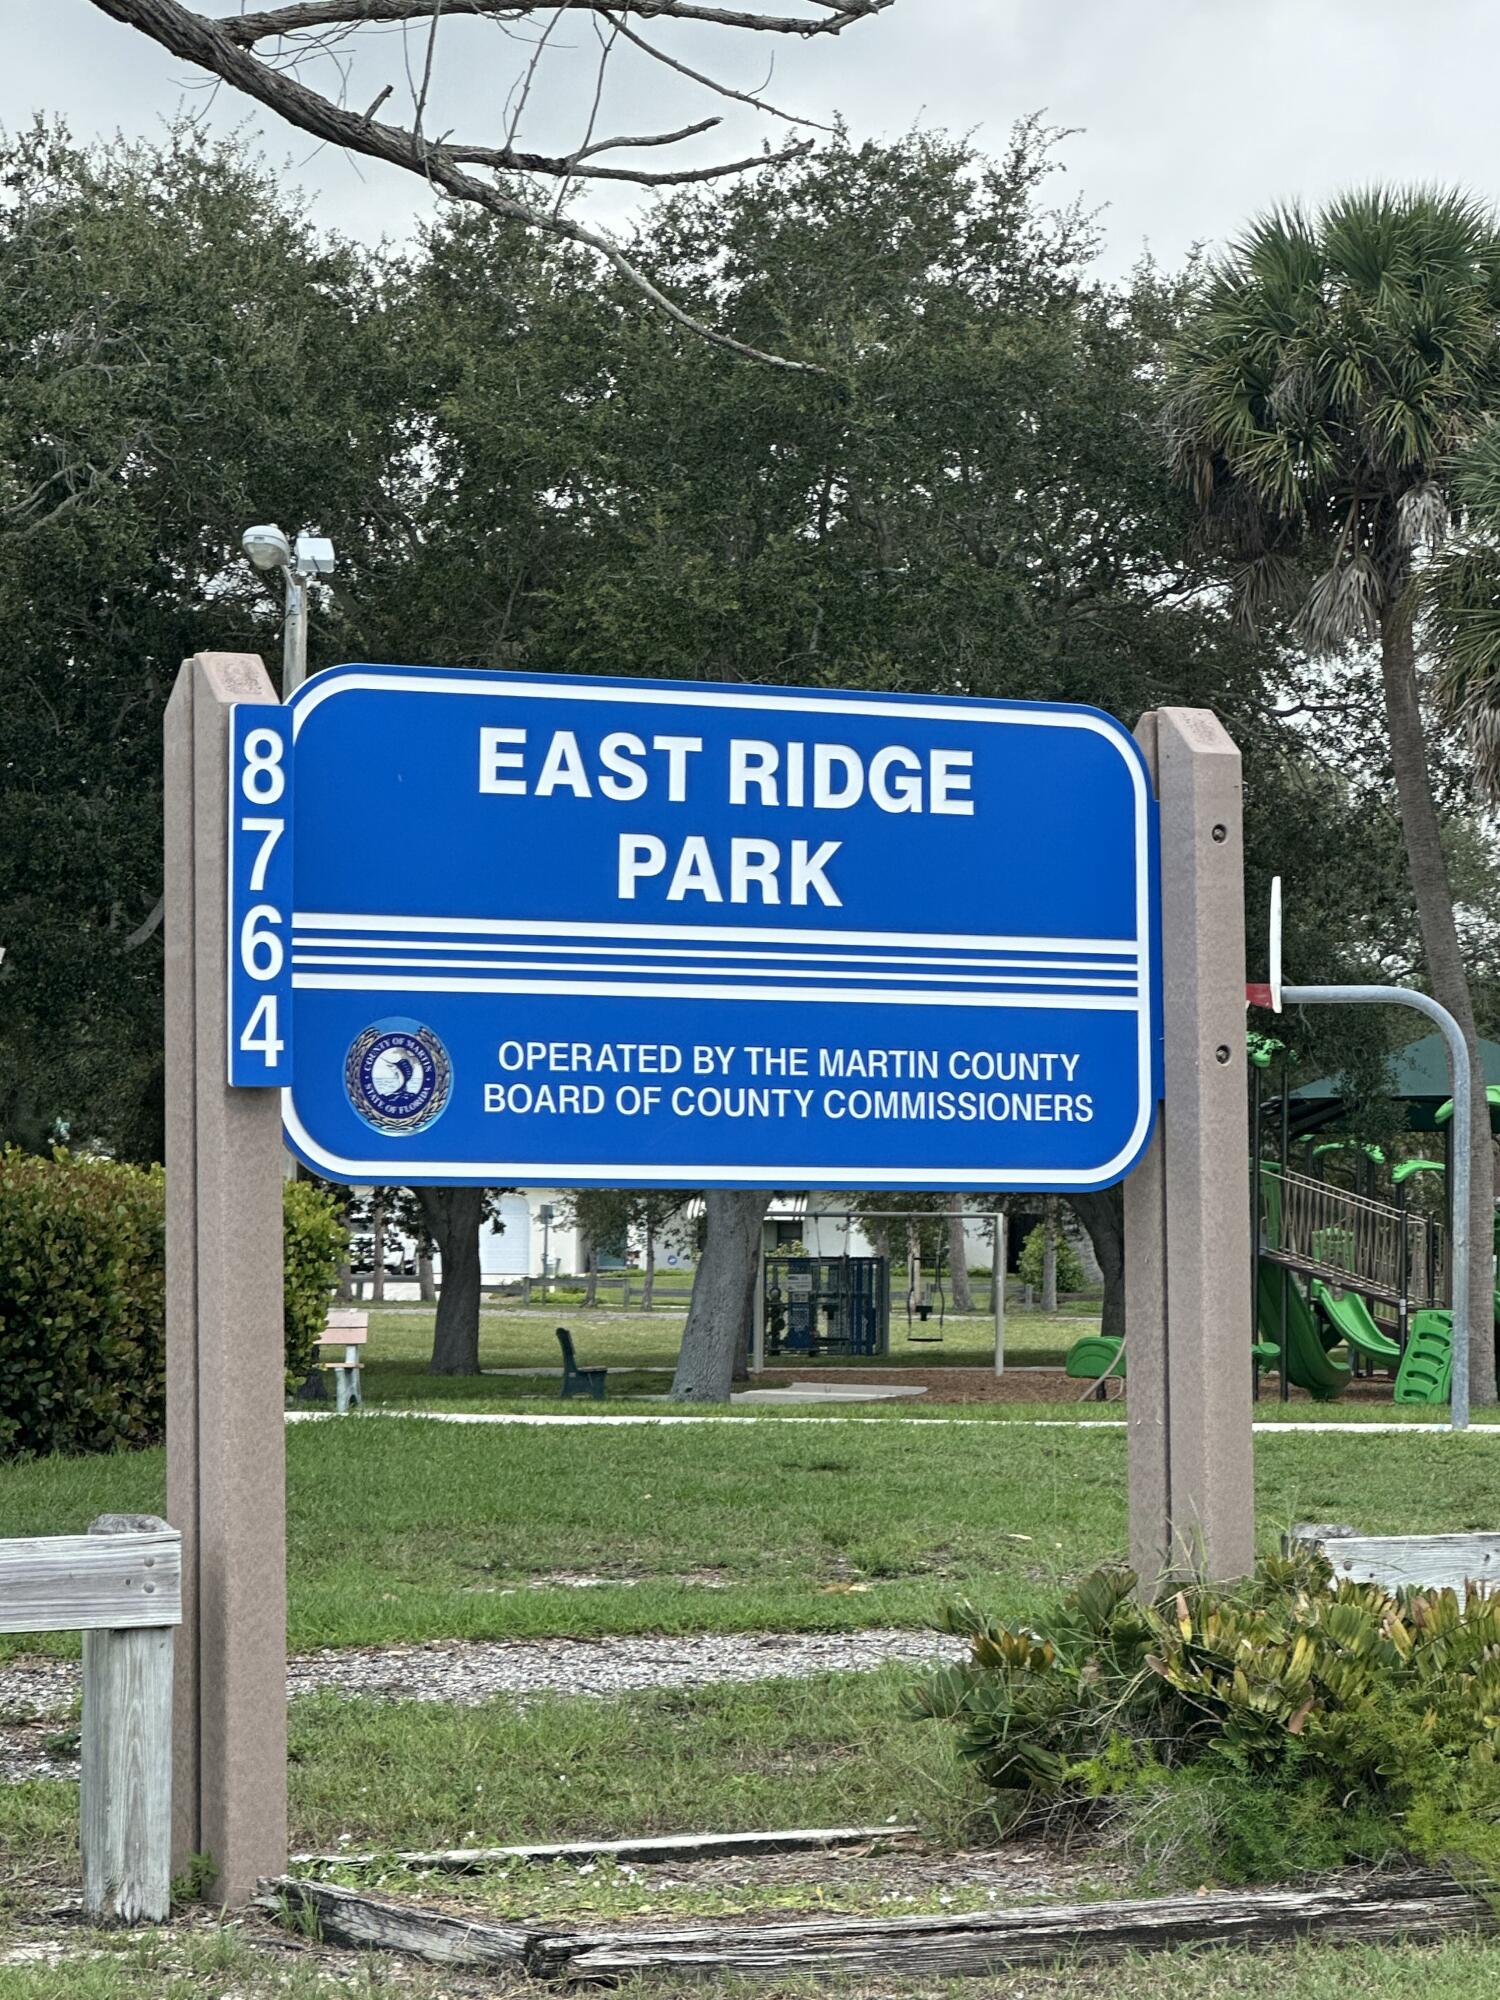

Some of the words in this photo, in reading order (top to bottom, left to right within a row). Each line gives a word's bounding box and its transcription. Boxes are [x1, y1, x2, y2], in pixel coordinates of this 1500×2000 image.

[478, 726, 703, 802] EAST
[729, 738, 975, 816] RIDGE
[618, 833, 843, 907] PARK
[240, 727, 285, 1067] 8764
[364, 1041, 390, 1071] COUNTY
[407, 1040, 432, 1072] MARTIN
[498, 1040, 682, 1074] OPERATED
[693, 1045, 736, 1075] BY
[743, 1046, 809, 1076] THE
[819, 1048, 938, 1079] MARTIN
[948, 1050, 1080, 1082] COUNTY
[364, 1084, 384, 1109] STATE
[386, 1106, 395, 1114] OF
[484, 1083, 605, 1114] BOARD
[615, 1085, 662, 1115] OF
[671, 1086, 814, 1118] COUNTY
[823, 1089, 1094, 1123] COMMISSIONERS
